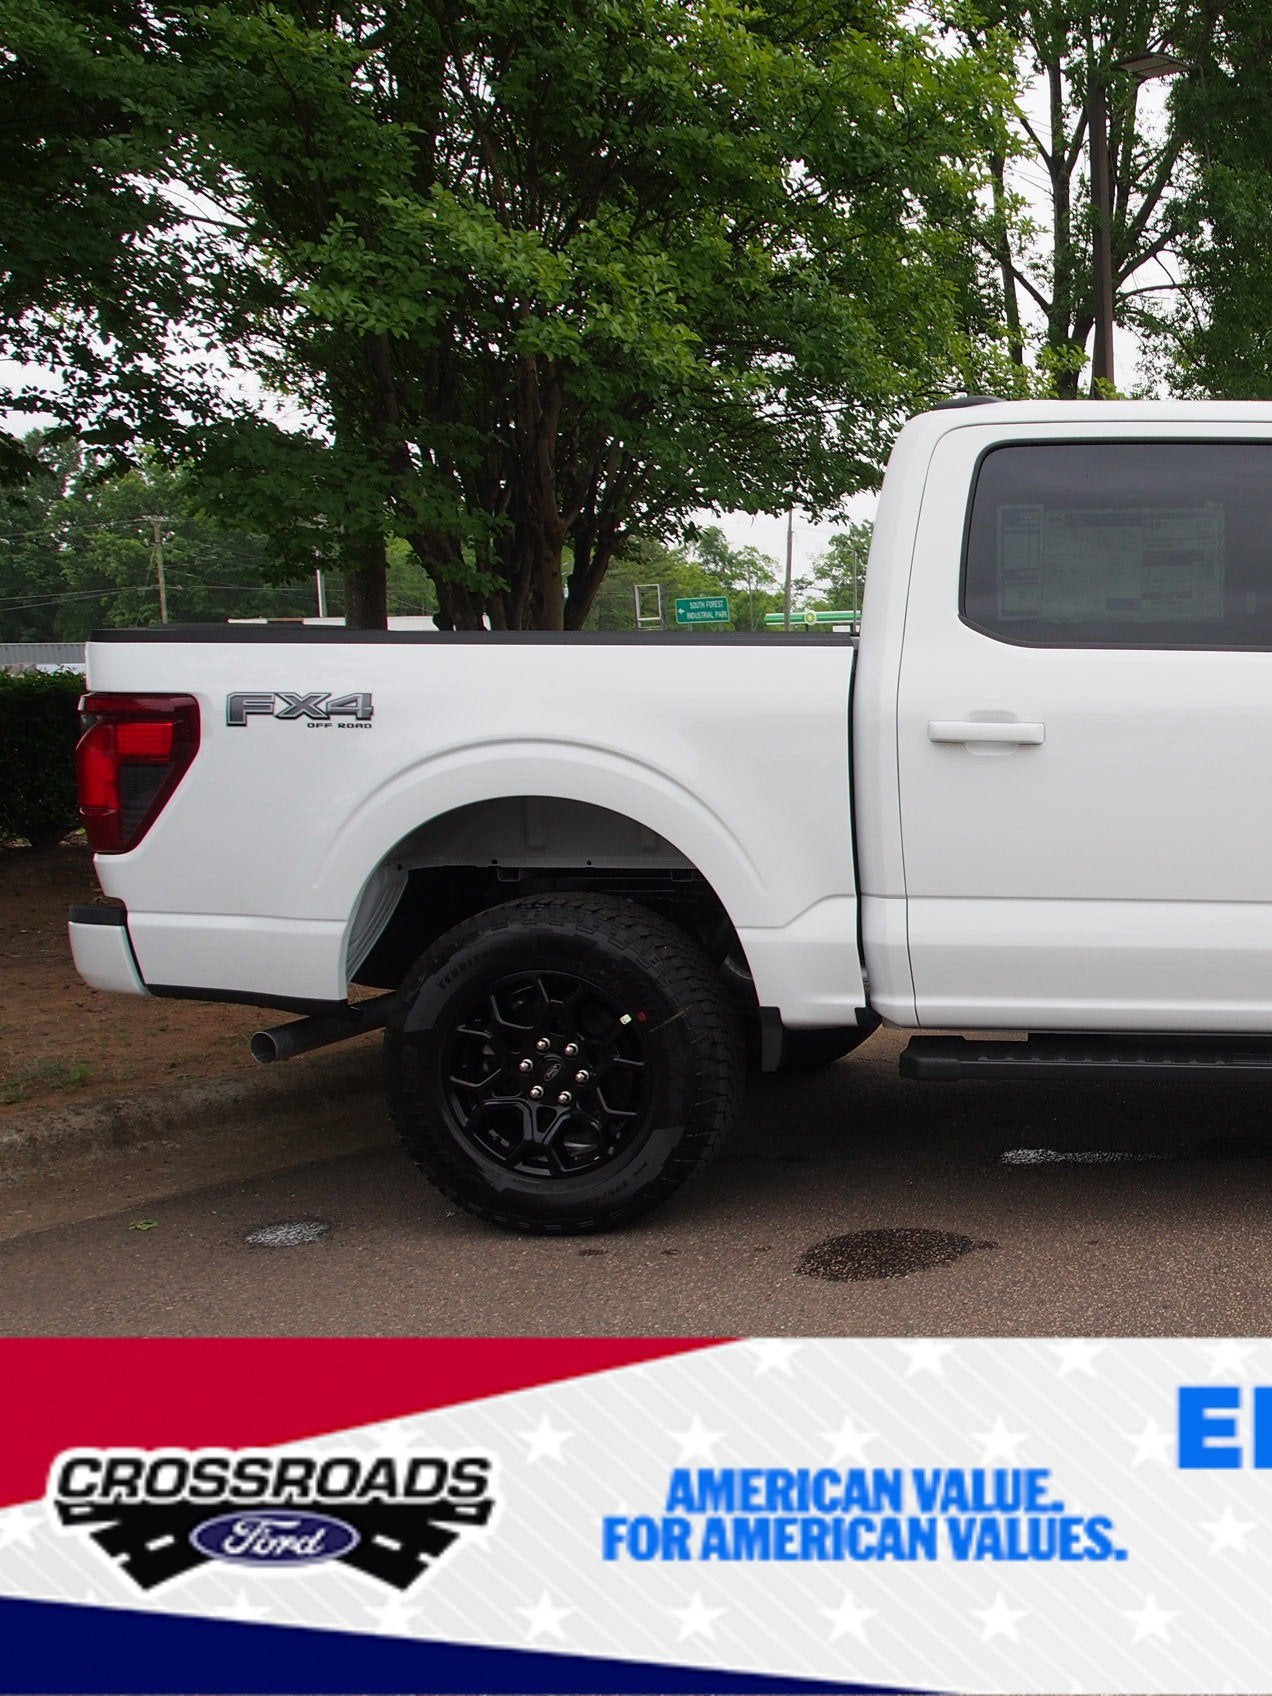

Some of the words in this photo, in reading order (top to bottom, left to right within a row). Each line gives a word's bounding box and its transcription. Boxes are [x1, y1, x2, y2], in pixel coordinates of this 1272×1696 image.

[690, 601, 705, 609] SOUTH
[706, 600, 724, 608] FOREST
[687, 611, 715, 620] INDUSTRIAL
[715, 610, 728, 618] PARK
[226, 692, 373, 727] FX4
